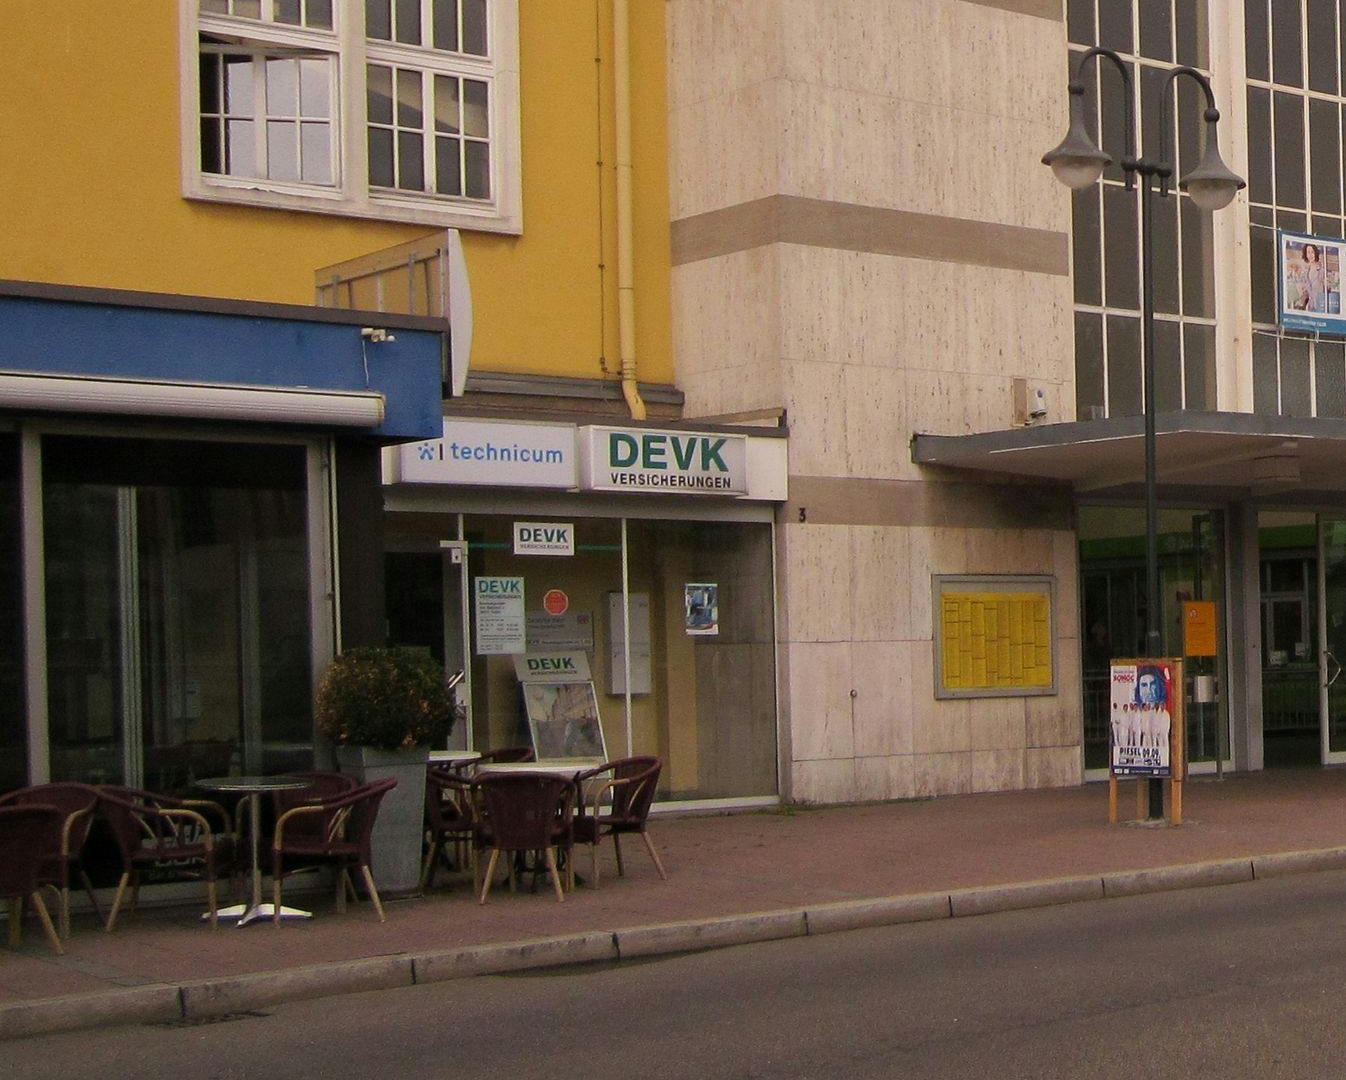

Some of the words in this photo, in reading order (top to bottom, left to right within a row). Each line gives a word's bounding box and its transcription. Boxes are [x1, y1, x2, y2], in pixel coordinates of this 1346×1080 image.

[450, 442, 563, 463] technicum
[609, 432, 729, 472] DEVK
[610, 472, 731, 488] VERSICHERUNGEN
[798, 507, 806, 523] 3
[519, 527, 568, 543] DEVK
[478, 580, 520, 593] DEVK
[527, 657, 575, 670] DEVK
